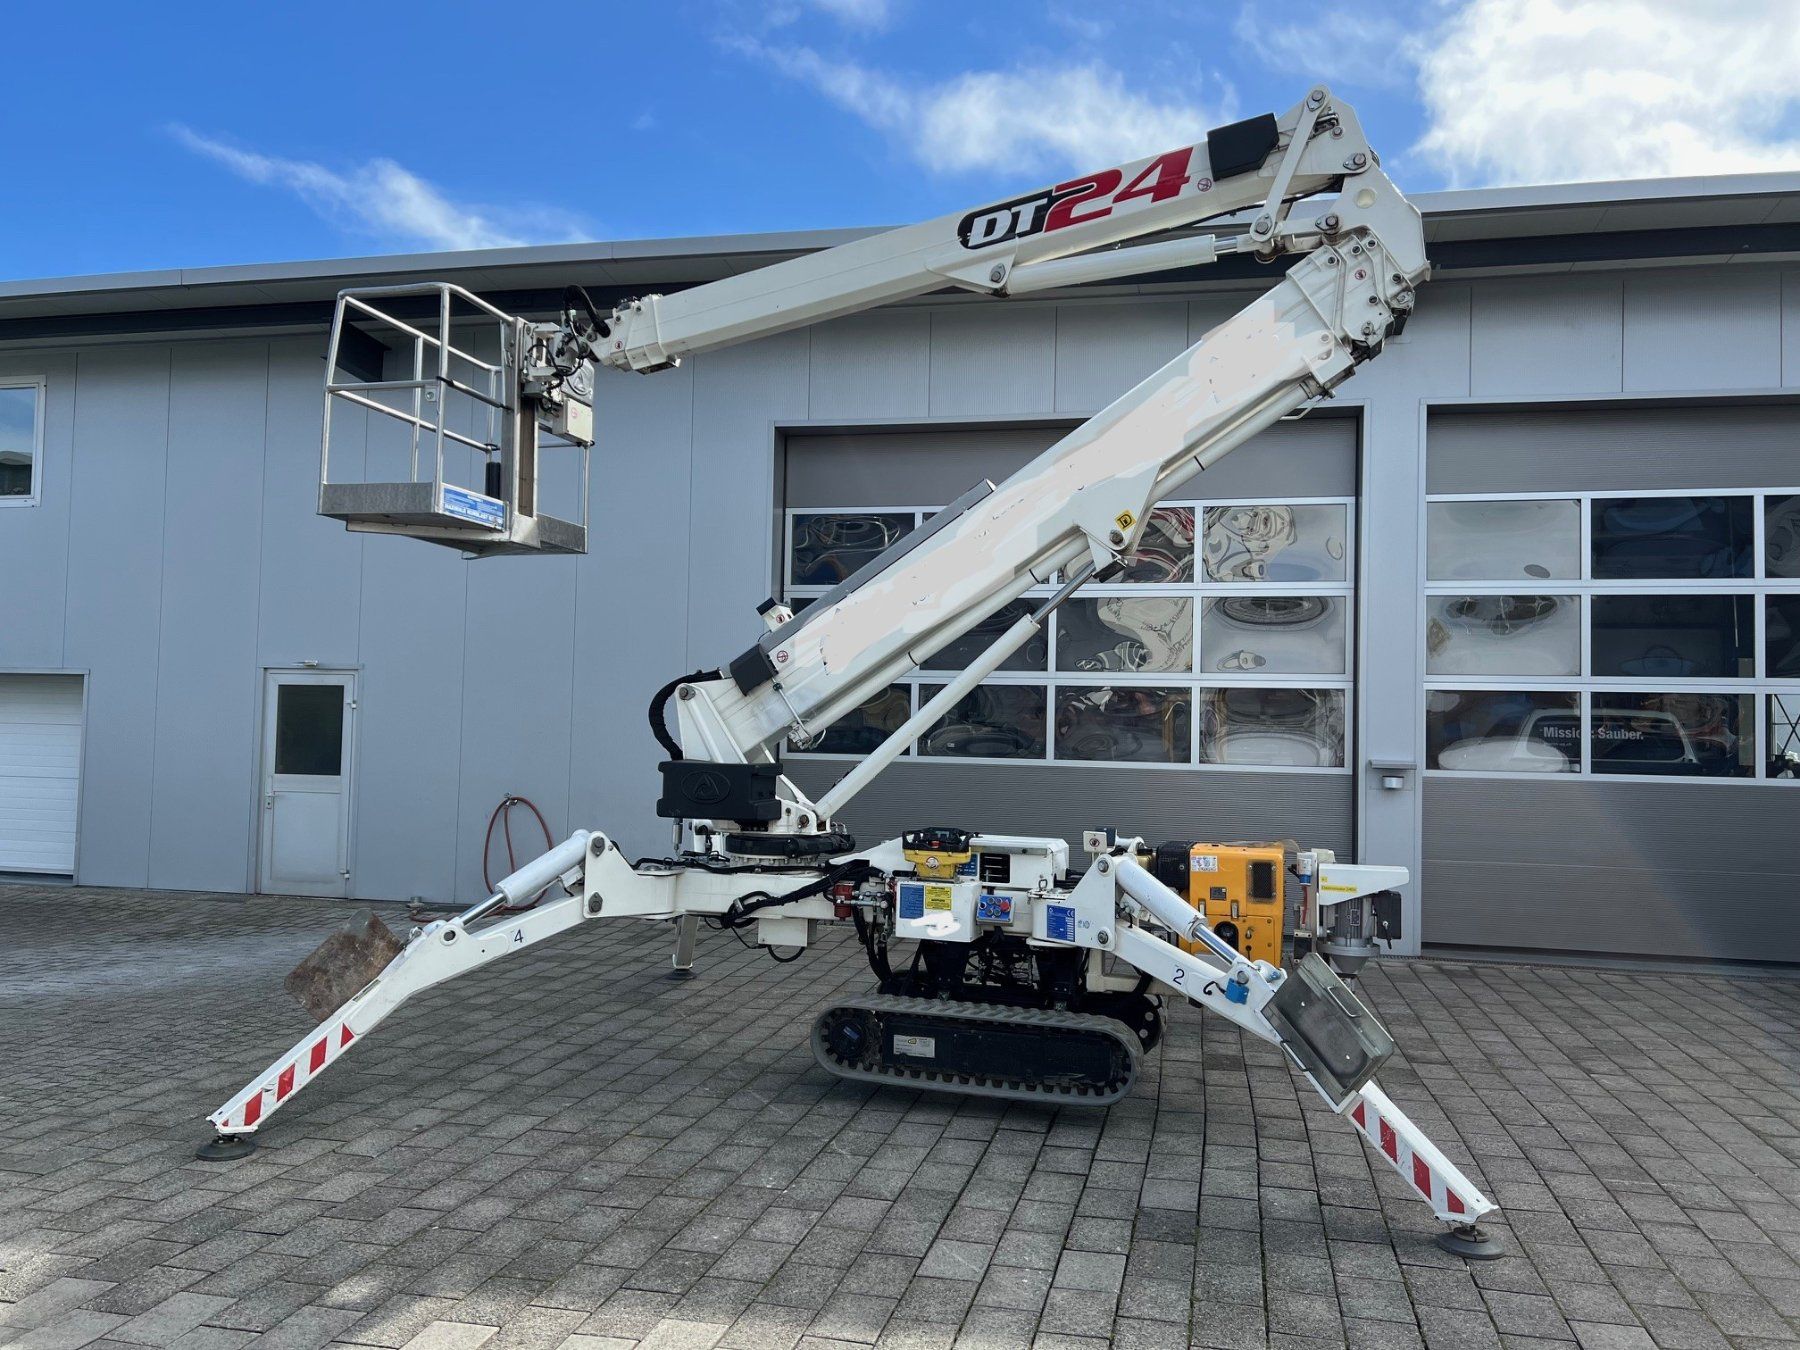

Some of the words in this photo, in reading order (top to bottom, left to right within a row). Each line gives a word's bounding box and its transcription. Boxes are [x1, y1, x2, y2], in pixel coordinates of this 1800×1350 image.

[966, 146, 1194, 248] DT24
[1598, 727, 1644, 740] Sauber.
[514, 929, 524, 943] 4
[1172, 968, 1185, 986] 2
